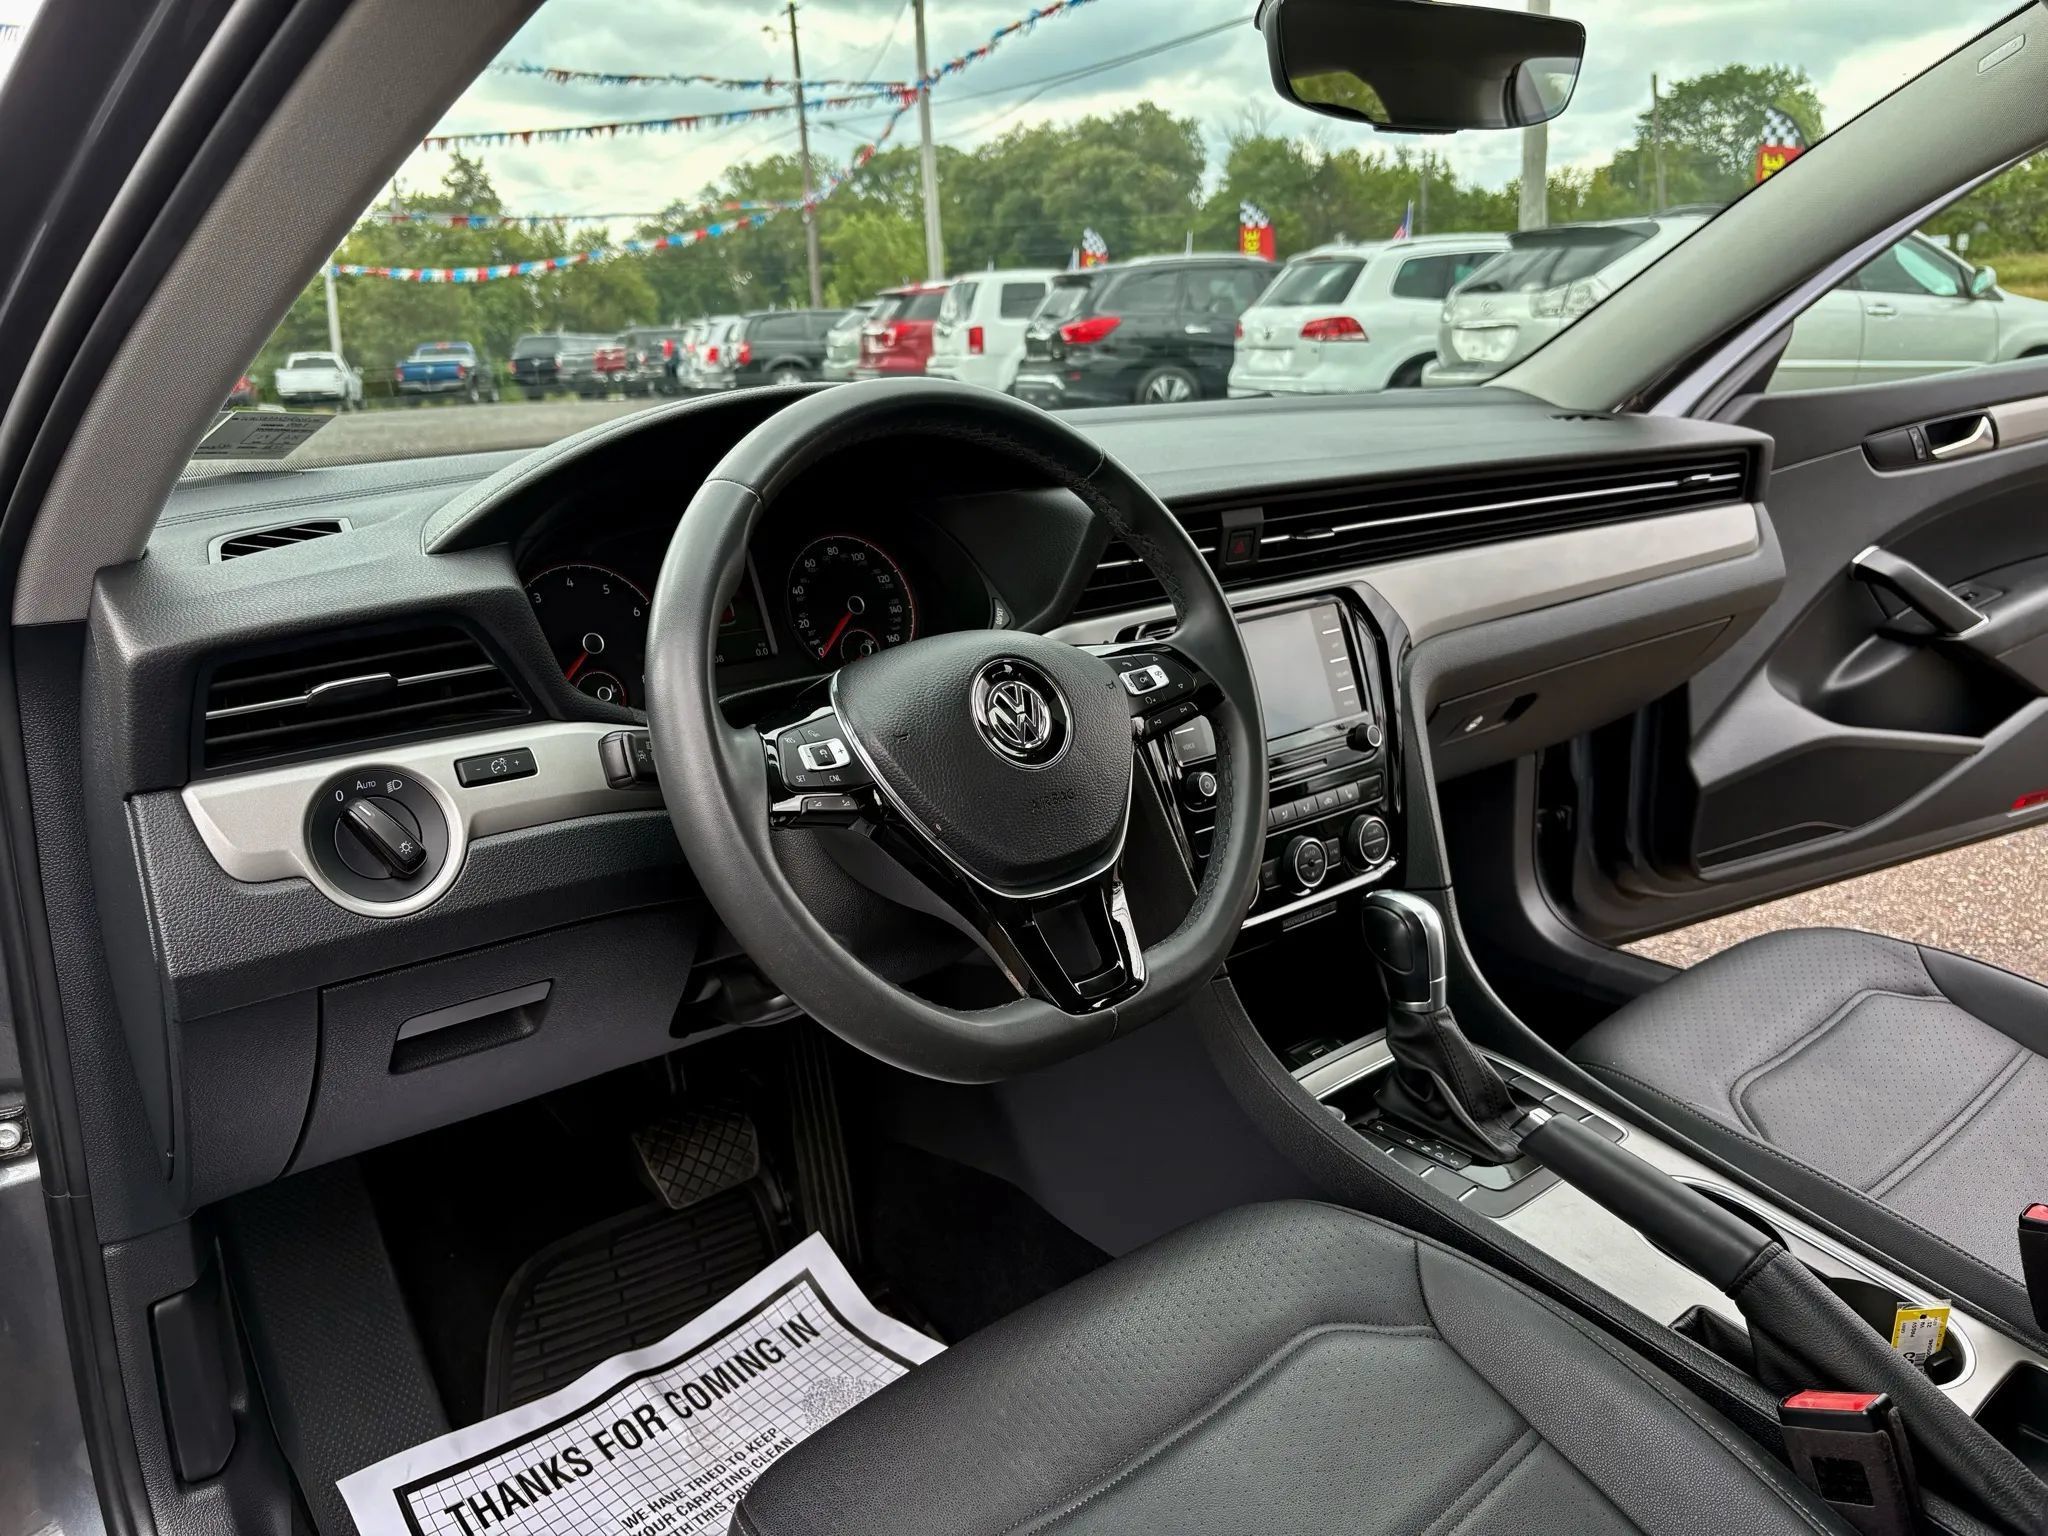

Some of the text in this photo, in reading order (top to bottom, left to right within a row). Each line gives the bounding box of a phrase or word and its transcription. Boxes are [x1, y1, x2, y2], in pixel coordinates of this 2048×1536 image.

[827, 546, 839, 556] 80
[851, 552, 865, 562] 100
[804, 559, 816, 568] 60
[566, 578, 574, 588] 4
[877, 574, 890, 583] 120
[602, 584, 610, 595] 5
[792, 585, 804, 595] 40
[533, 592, 542, 604] 3
[633, 607, 641, 617] 6
[798, 619, 810, 629] 20
[886, 633, 901, 643] 160
[444, 1313, 820, 1536] THANKS FOR COMING IN
[621, 1427, 778, 1529] WE HAVE TRIED TO KEEP
[676, 1465, 752, 1517] CARPETING
[751, 1437, 795, 1469] CLEAN
[691, 1502, 728, 1527] THIS
